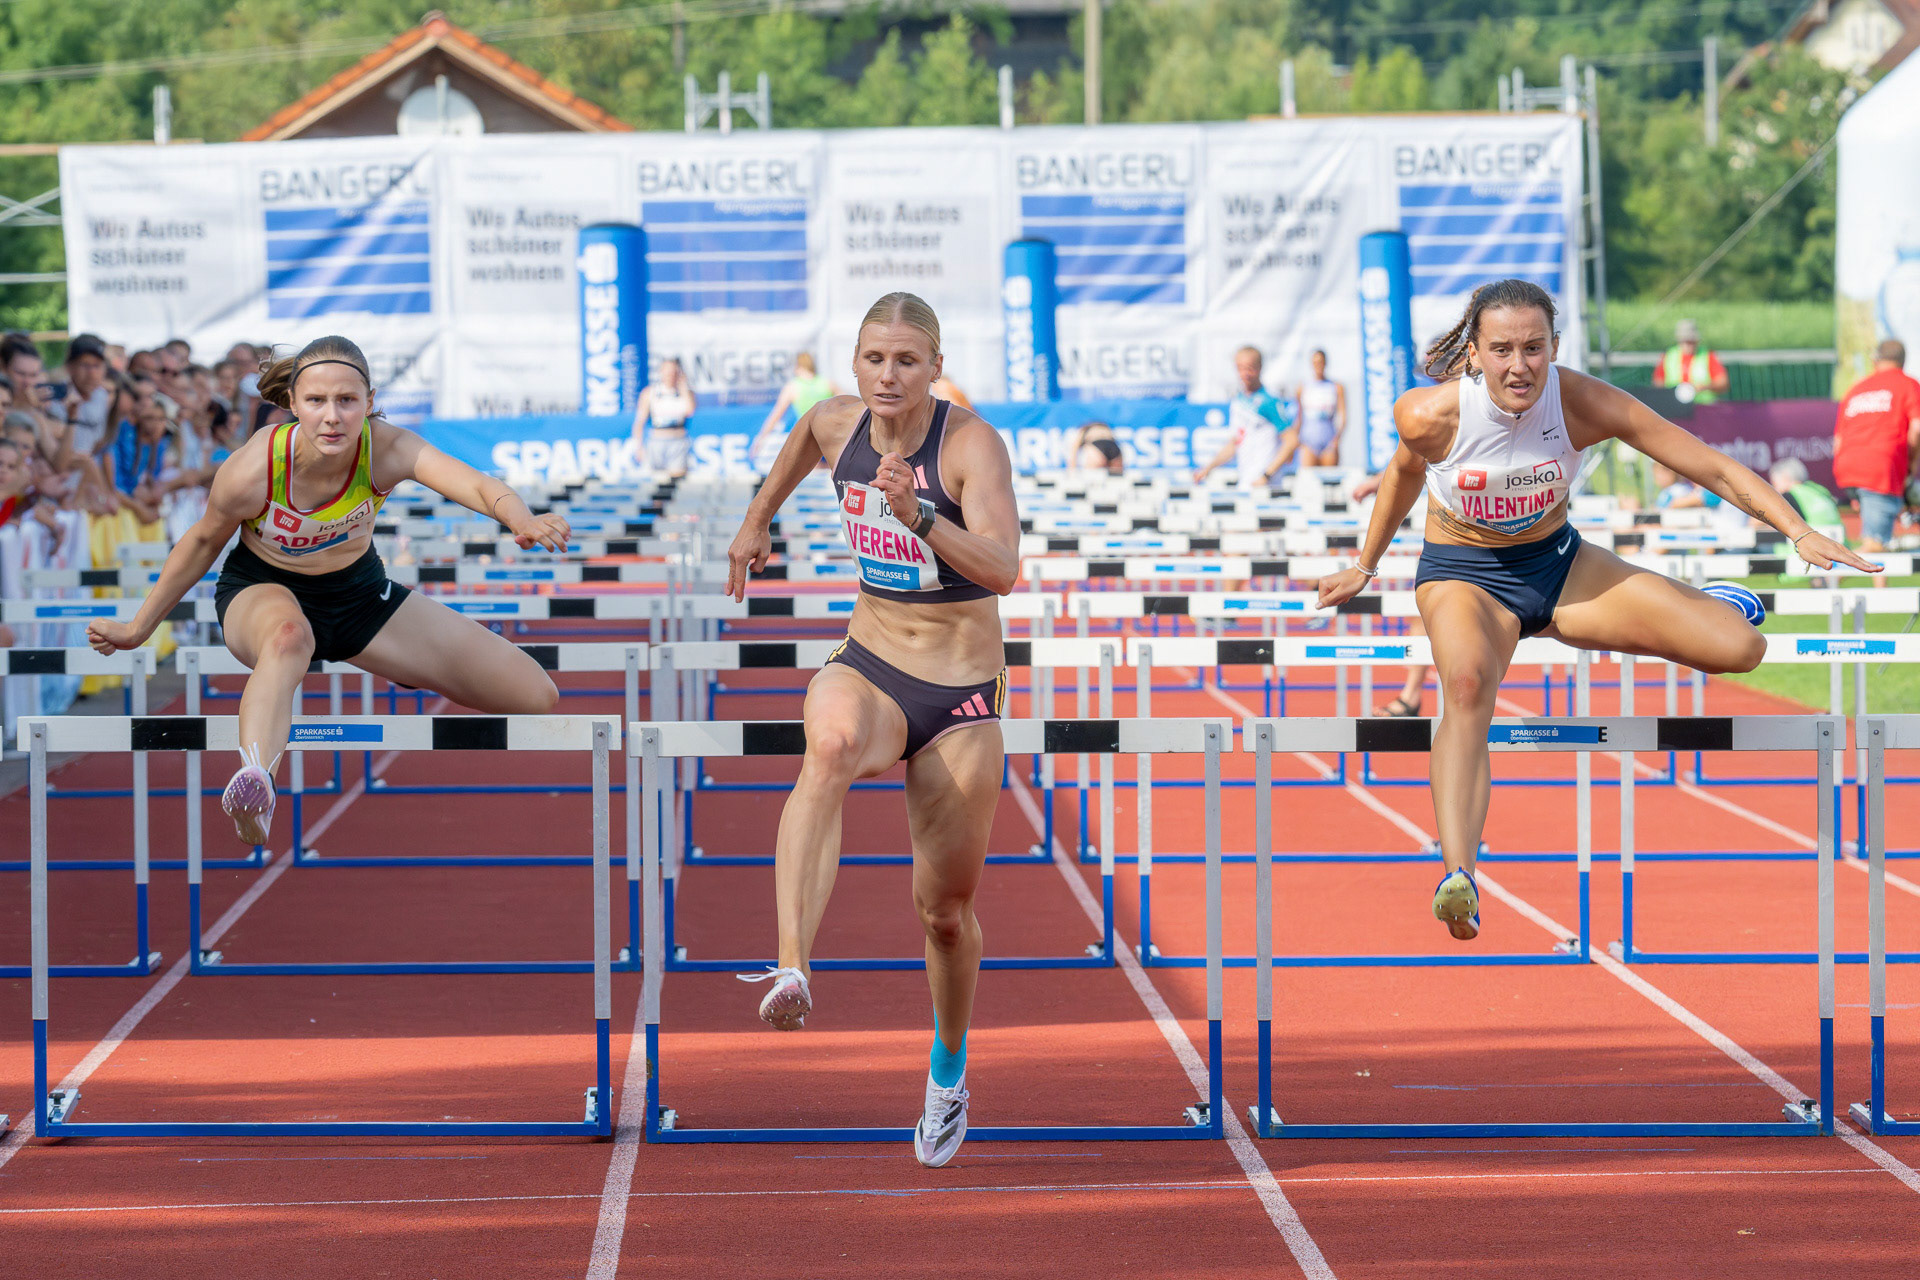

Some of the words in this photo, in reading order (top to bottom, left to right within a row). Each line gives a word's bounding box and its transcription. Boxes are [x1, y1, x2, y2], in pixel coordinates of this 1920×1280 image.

[637, 159, 810, 194] BANGERL
[1017, 153, 1189, 188] BANGERL
[1543, 434, 1560, 442] AIR
[1505, 467, 1557, 490] josko
[1461, 488, 1555, 519] VALENTINA
[847, 520, 927, 564] VERENA
[866, 566, 903, 580] SPARKASSE
[295, 728, 335, 736] SPARKASSE
[1510, 729, 1551, 737] SPARKASSE
